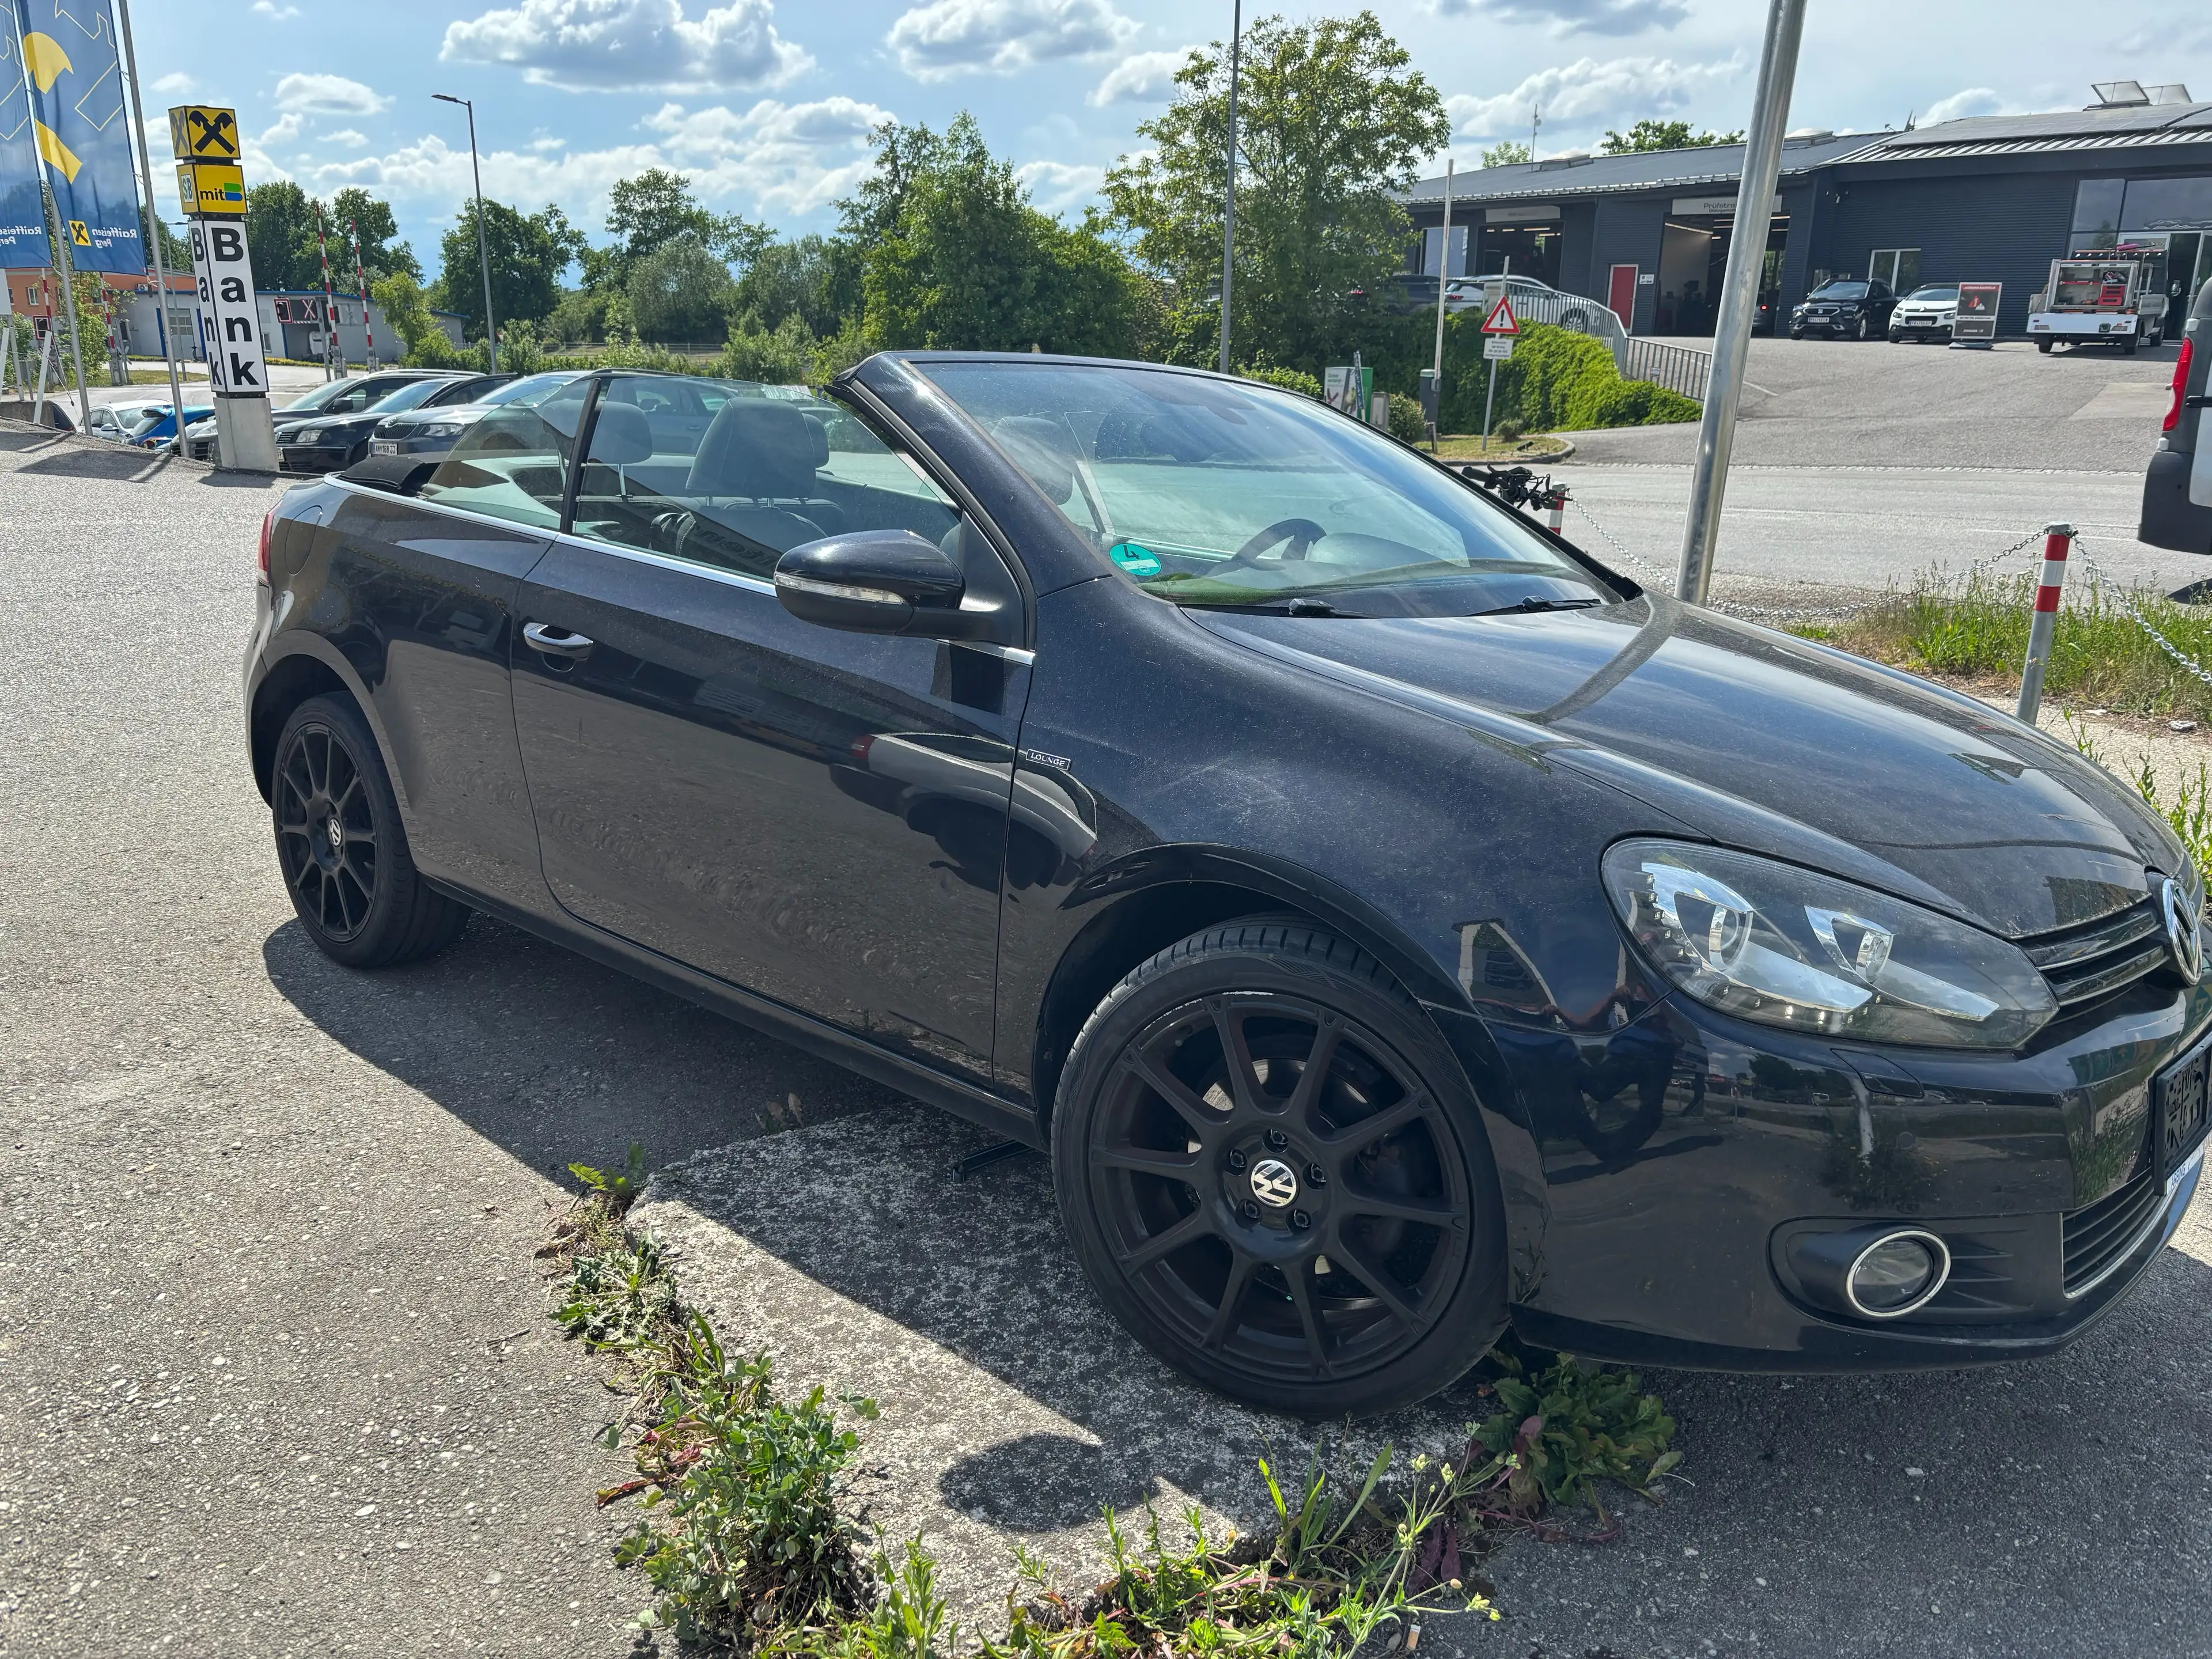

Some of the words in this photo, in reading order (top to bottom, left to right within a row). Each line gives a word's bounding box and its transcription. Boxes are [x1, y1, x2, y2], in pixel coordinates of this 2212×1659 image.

[182, 177, 192, 200] SB
[191, 228, 222, 385] Bank
[211, 228, 260, 385] Bank
[1123, 545, 1141, 560] 4
[1031, 752, 1066, 767] LOUNGE
